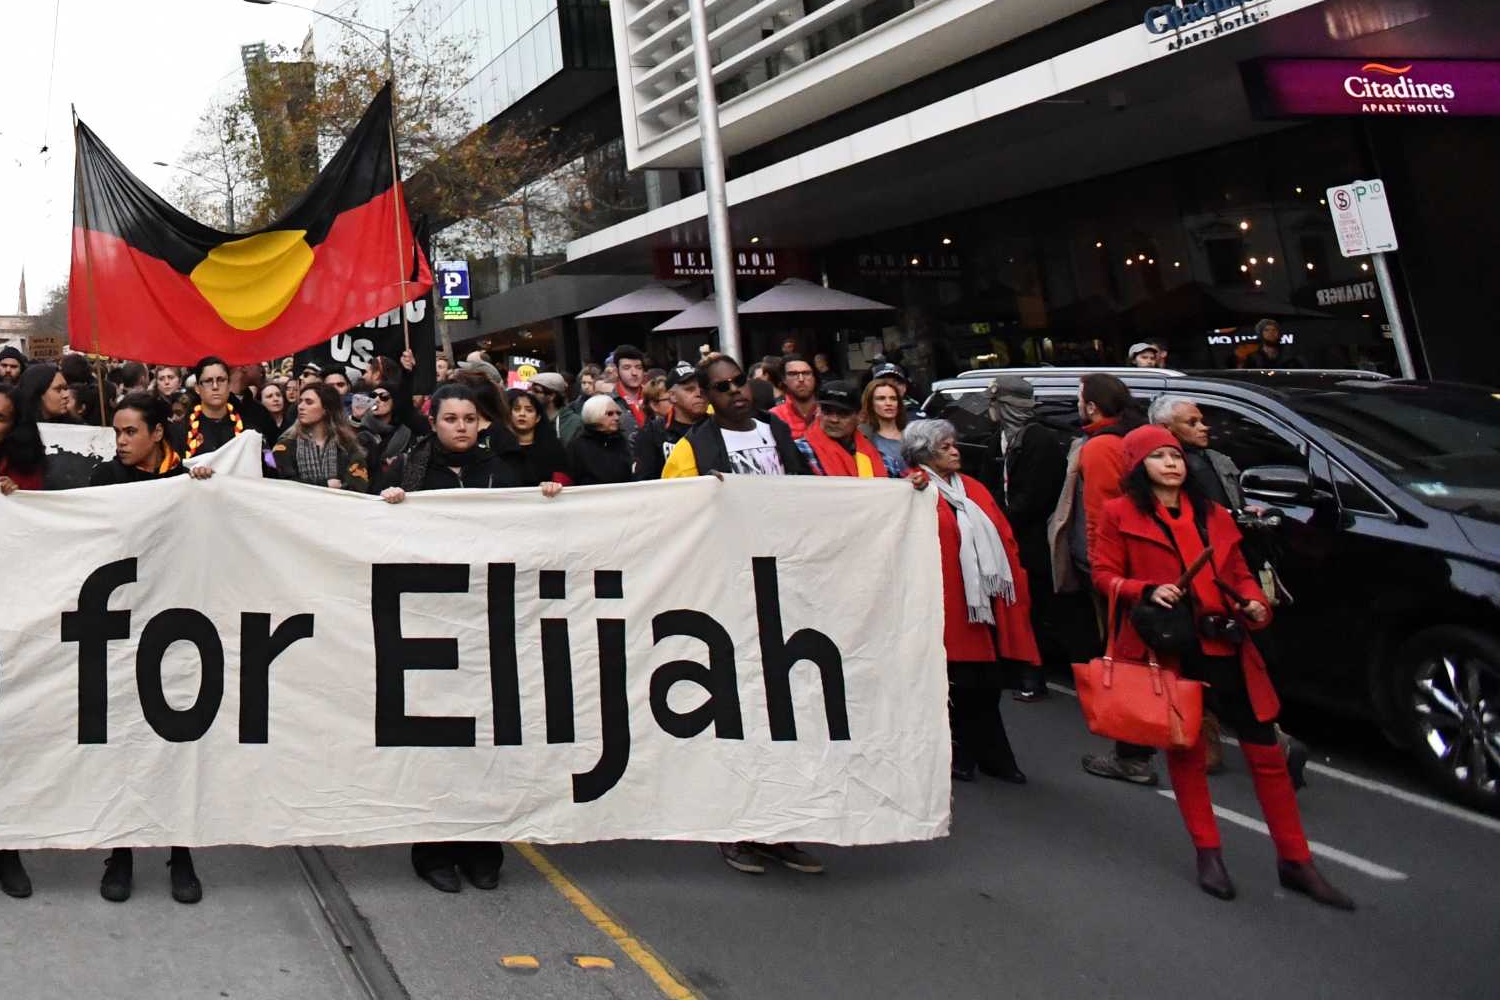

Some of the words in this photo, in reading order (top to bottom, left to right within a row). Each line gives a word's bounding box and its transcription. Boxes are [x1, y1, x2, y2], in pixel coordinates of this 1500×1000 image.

[1344, 76, 1455, 99] Citadines
[1356, 186, 1367, 202] P
[674, 251, 776, 267] HEIOOM
[331, 334, 374, 370] US
[514, 356, 541, 367] BLACK
[61, 557, 314, 744] for
[371, 556, 851, 804] Elijah
